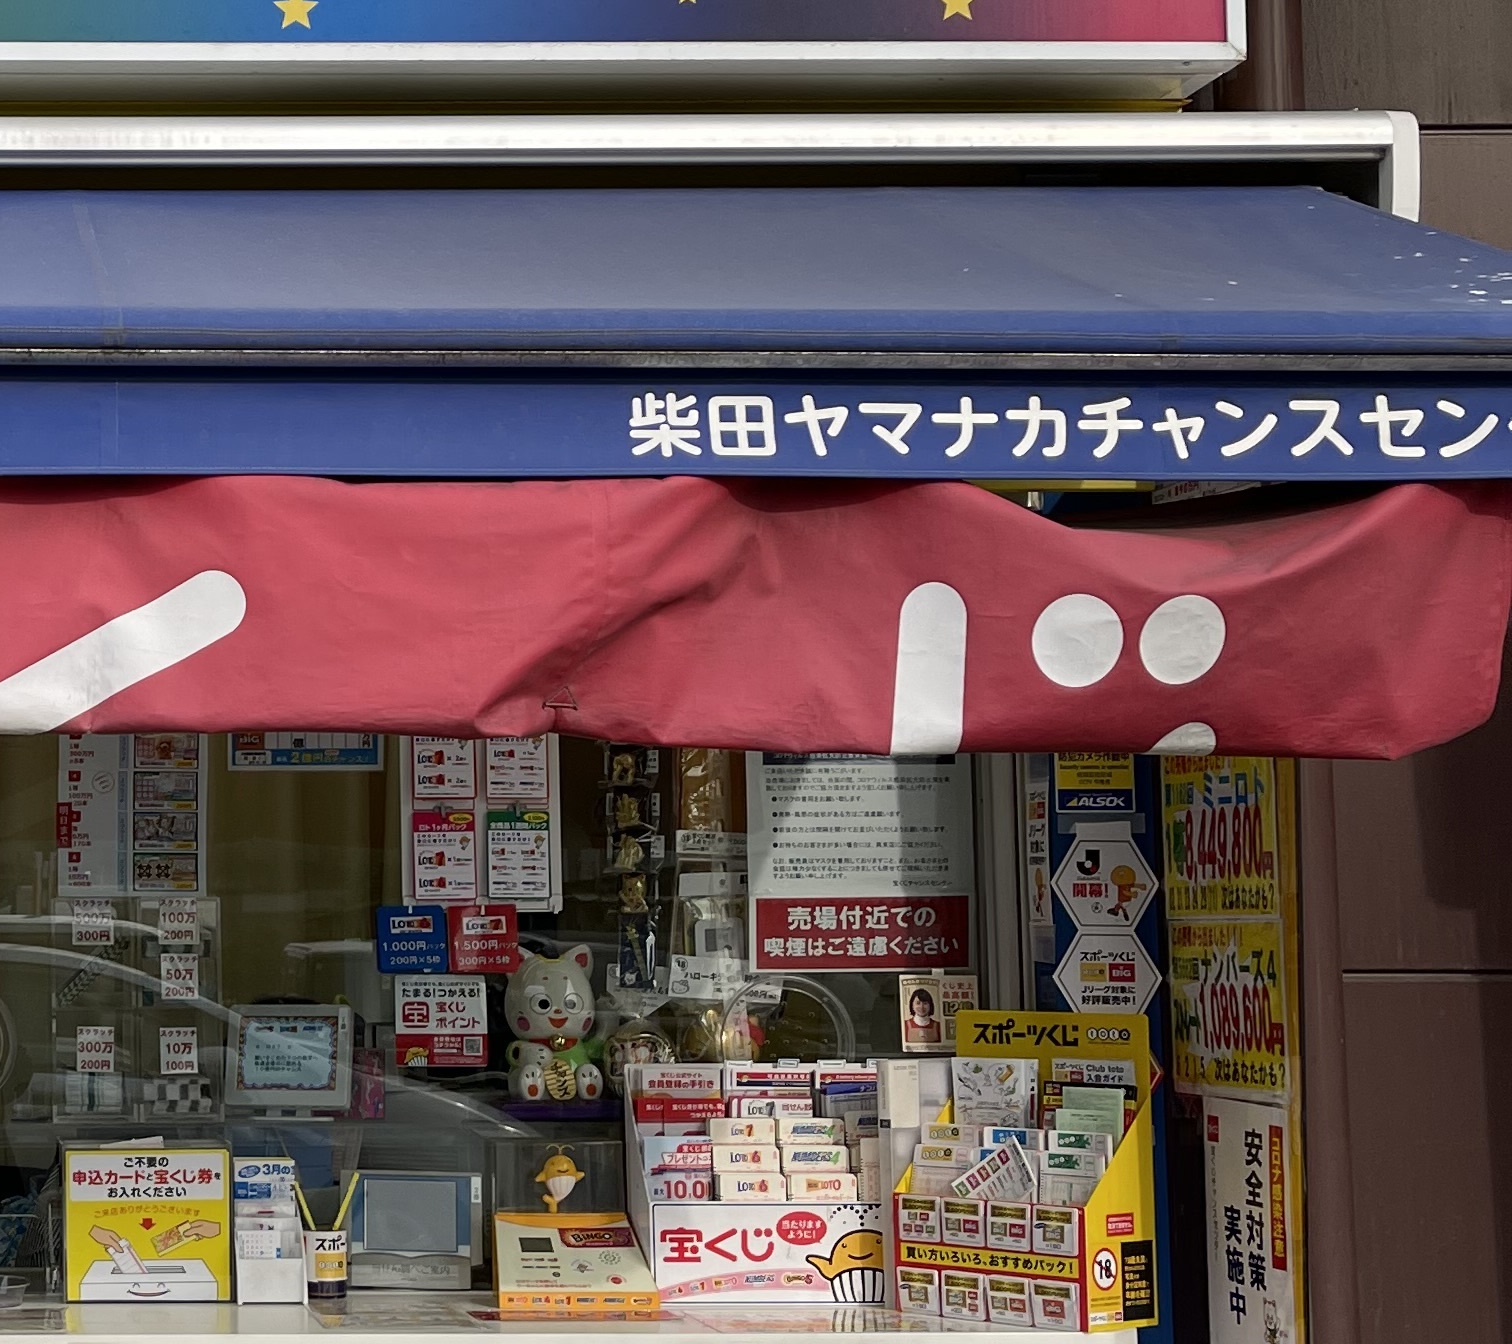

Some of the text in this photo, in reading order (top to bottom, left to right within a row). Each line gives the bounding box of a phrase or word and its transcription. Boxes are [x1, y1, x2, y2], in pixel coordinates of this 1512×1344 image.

[629, 391, 1512, 459] 柴田ヤマナカチャンスセン
[1203, 765, 1264, 808] ミニロト
[1078, 797, 1125, 806] ALSOK
[162, 912, 196, 923] 100万
[788, 906, 936, 931] 売場付近での
[77, 931, 110, 941] 300円
[164, 931, 194, 940] 200円
[763, 936, 959, 957] 喫煙はご遠慮ください
[1080, 950, 1135, 962] スポーツくじ
[1201, 948, 1276, 987] ナンバーズ4
[166, 969, 194, 980] 50万
[1081, 986, 1136, 994] Jリーグ対象に
[1081, 995, 1136, 1006] 好評販売中!
[435, 1001, 466, 1013] 宝くじ
[435, 1017, 481, 1029] ポイント
[973, 1018, 1078, 1047] スポーツくじ
[78, 1042, 114, 1053] 300万
[166, 1043, 193, 1054] 10万
[80, 1060, 111, 1070] 200円
[165, 1061, 194, 1071] 100円
[123, 1157, 170, 1168] ご不要の
[72, 1169, 221, 1186] 申込カードと宝くじ券を
[107, 1186, 187, 1198] お入れください
[1244, 1129, 1266, 1291] 安全対策
[781, 1220, 822, 1230] 当たります
[786, 1230, 817, 1240] ように!
[660, 1227, 775, 1262] 宝くじ
[906, 1246, 1074, 1274] 買い方いろいろ、おすすめパック!
[1224, 1205, 1246, 1324] 実施中
[1099, 1259, 1112, 1279] 18
